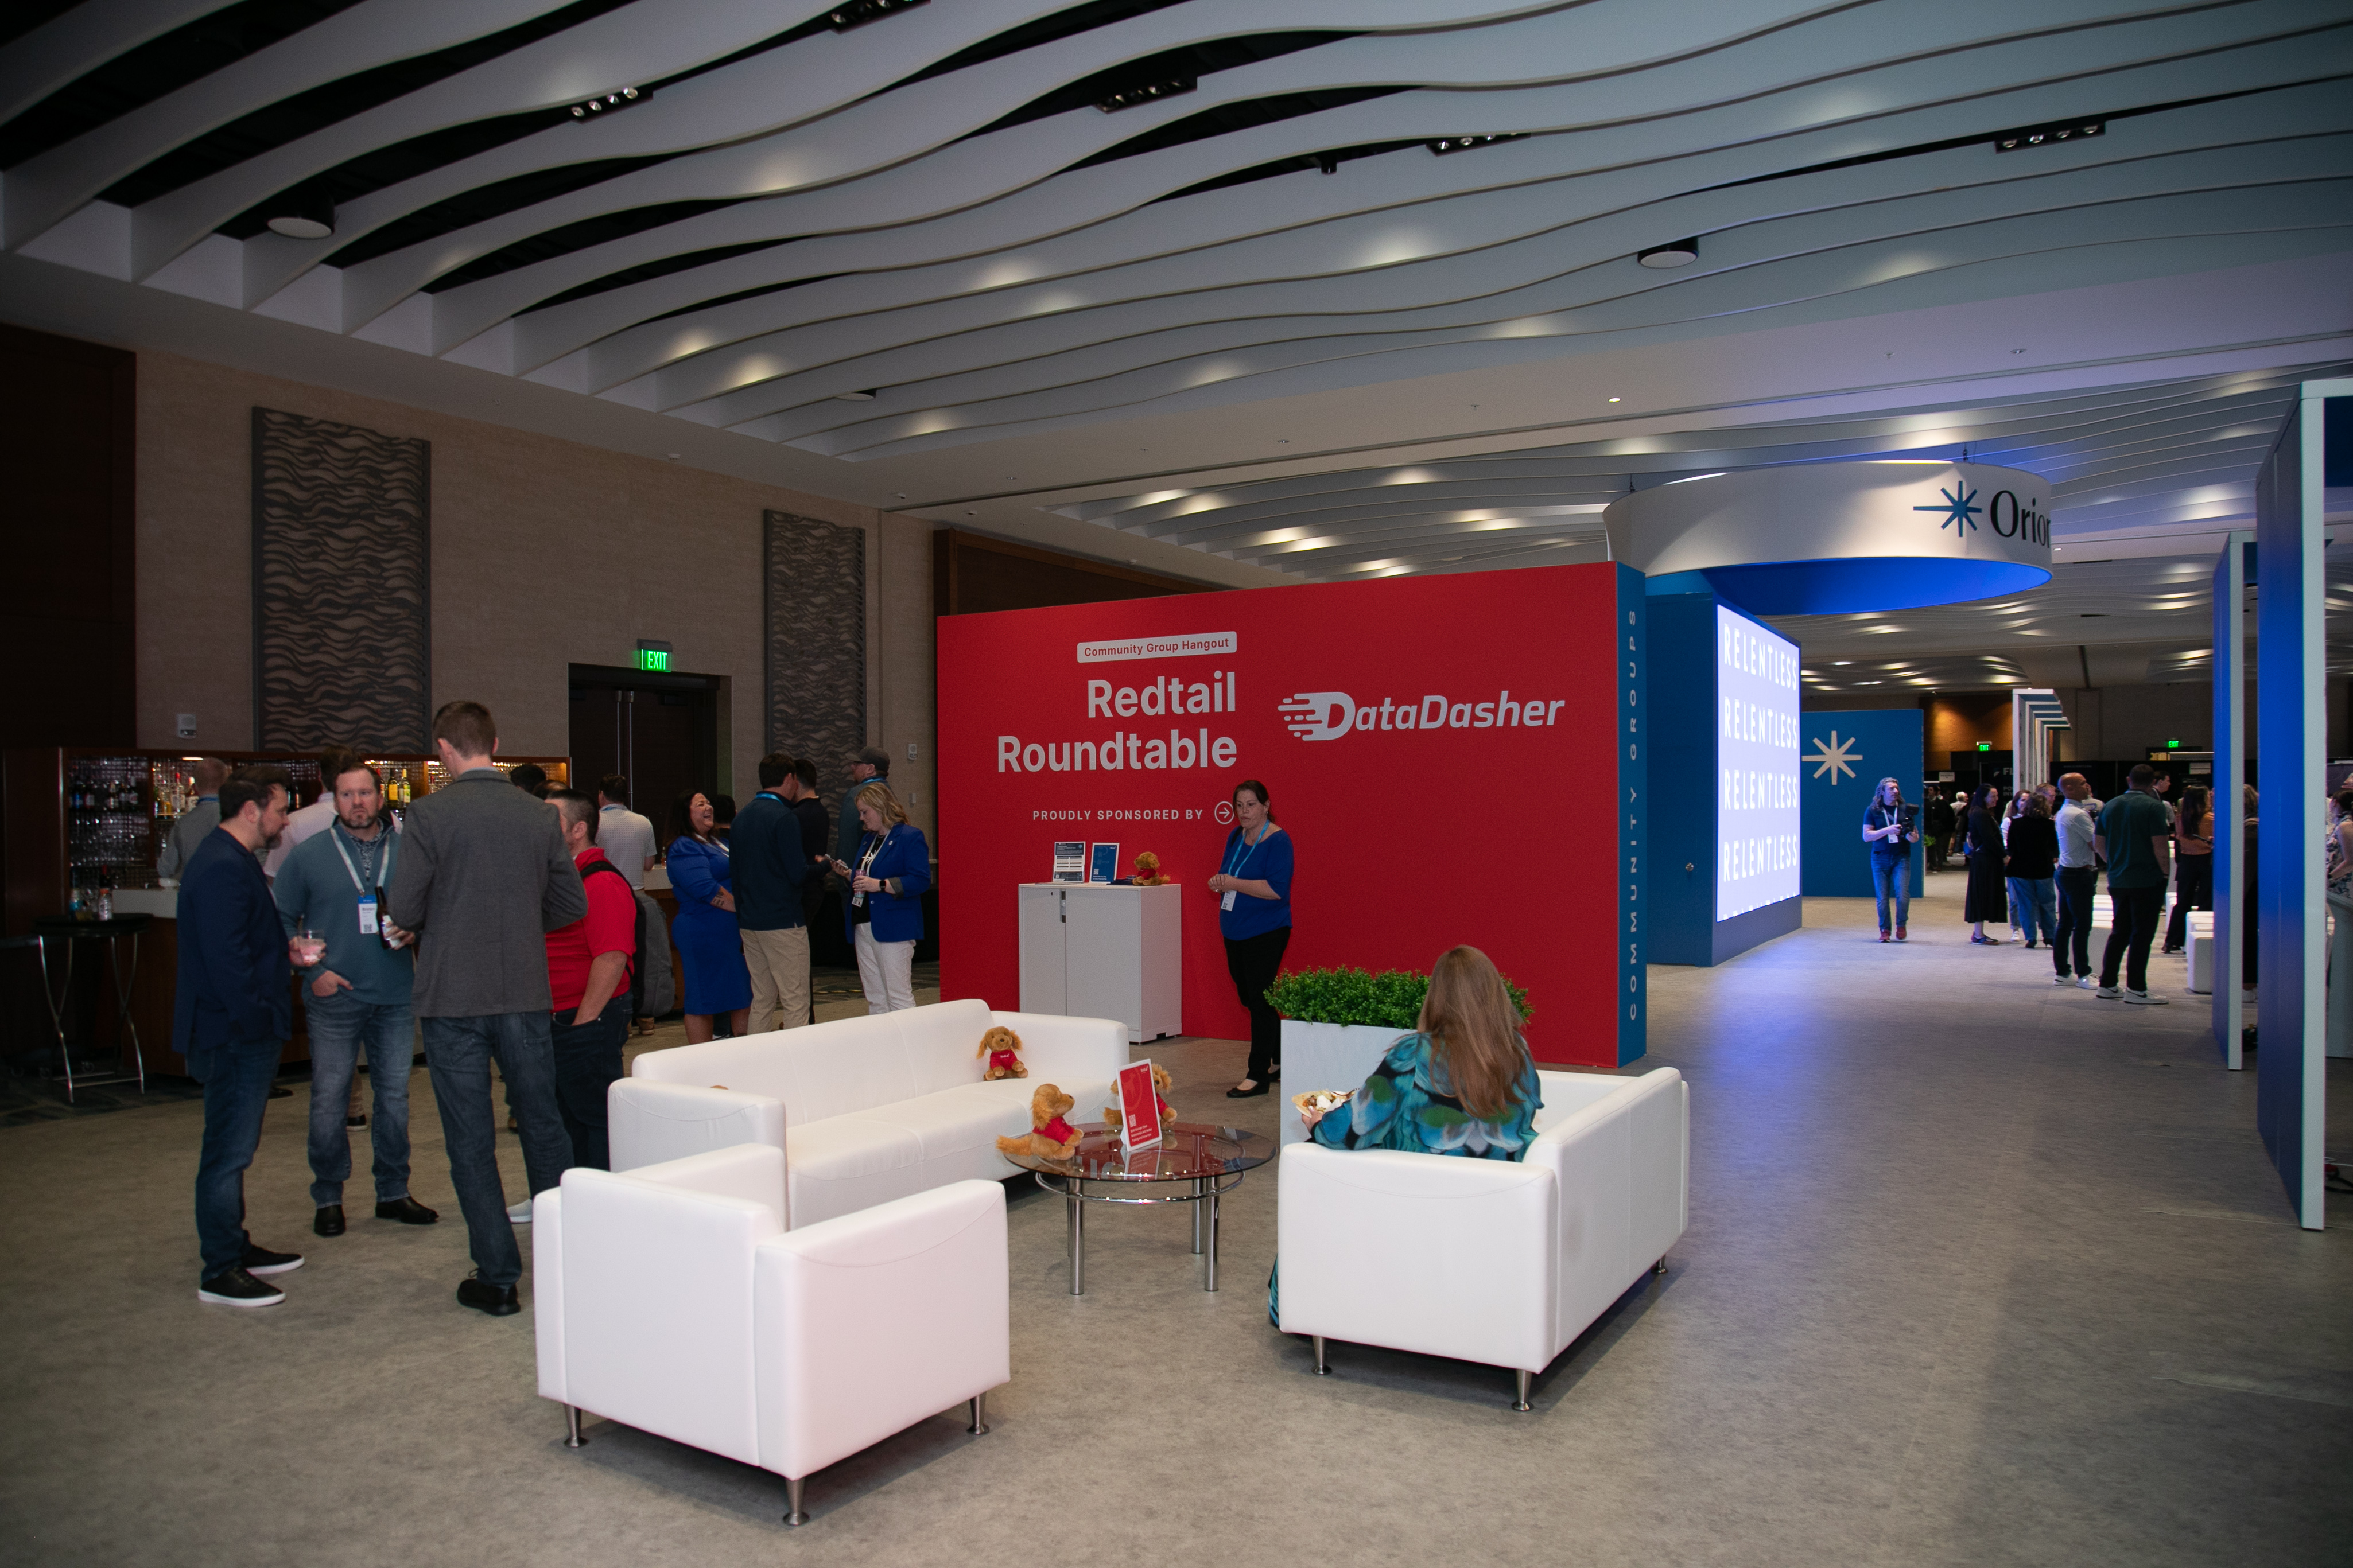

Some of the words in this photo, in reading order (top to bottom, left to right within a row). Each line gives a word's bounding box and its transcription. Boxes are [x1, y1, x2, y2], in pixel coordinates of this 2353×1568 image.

[647, 651, 667, 670] EXIT
[1084, 644, 1143, 657] Community
[1146, 641, 1179, 653] Group
[1182, 638, 1229, 651] Hangout
[1724, 624, 1797, 691] RELENTLESS
[1088, 670, 1236, 718] Redtail
[1278, 690, 1566, 741] DataDasher
[1724, 696, 1797, 749] RELENTLESS
[998, 728, 1237, 772] Roundtable
[1724, 769, 1797, 810] RELENTLESS
[1033, 810, 1092, 820] PROUDLY
[1097, 809, 1179, 820] SPONSORED
[1186, 809, 1203, 820] BY
[1724, 834, 1797, 883] RELENTLESS
